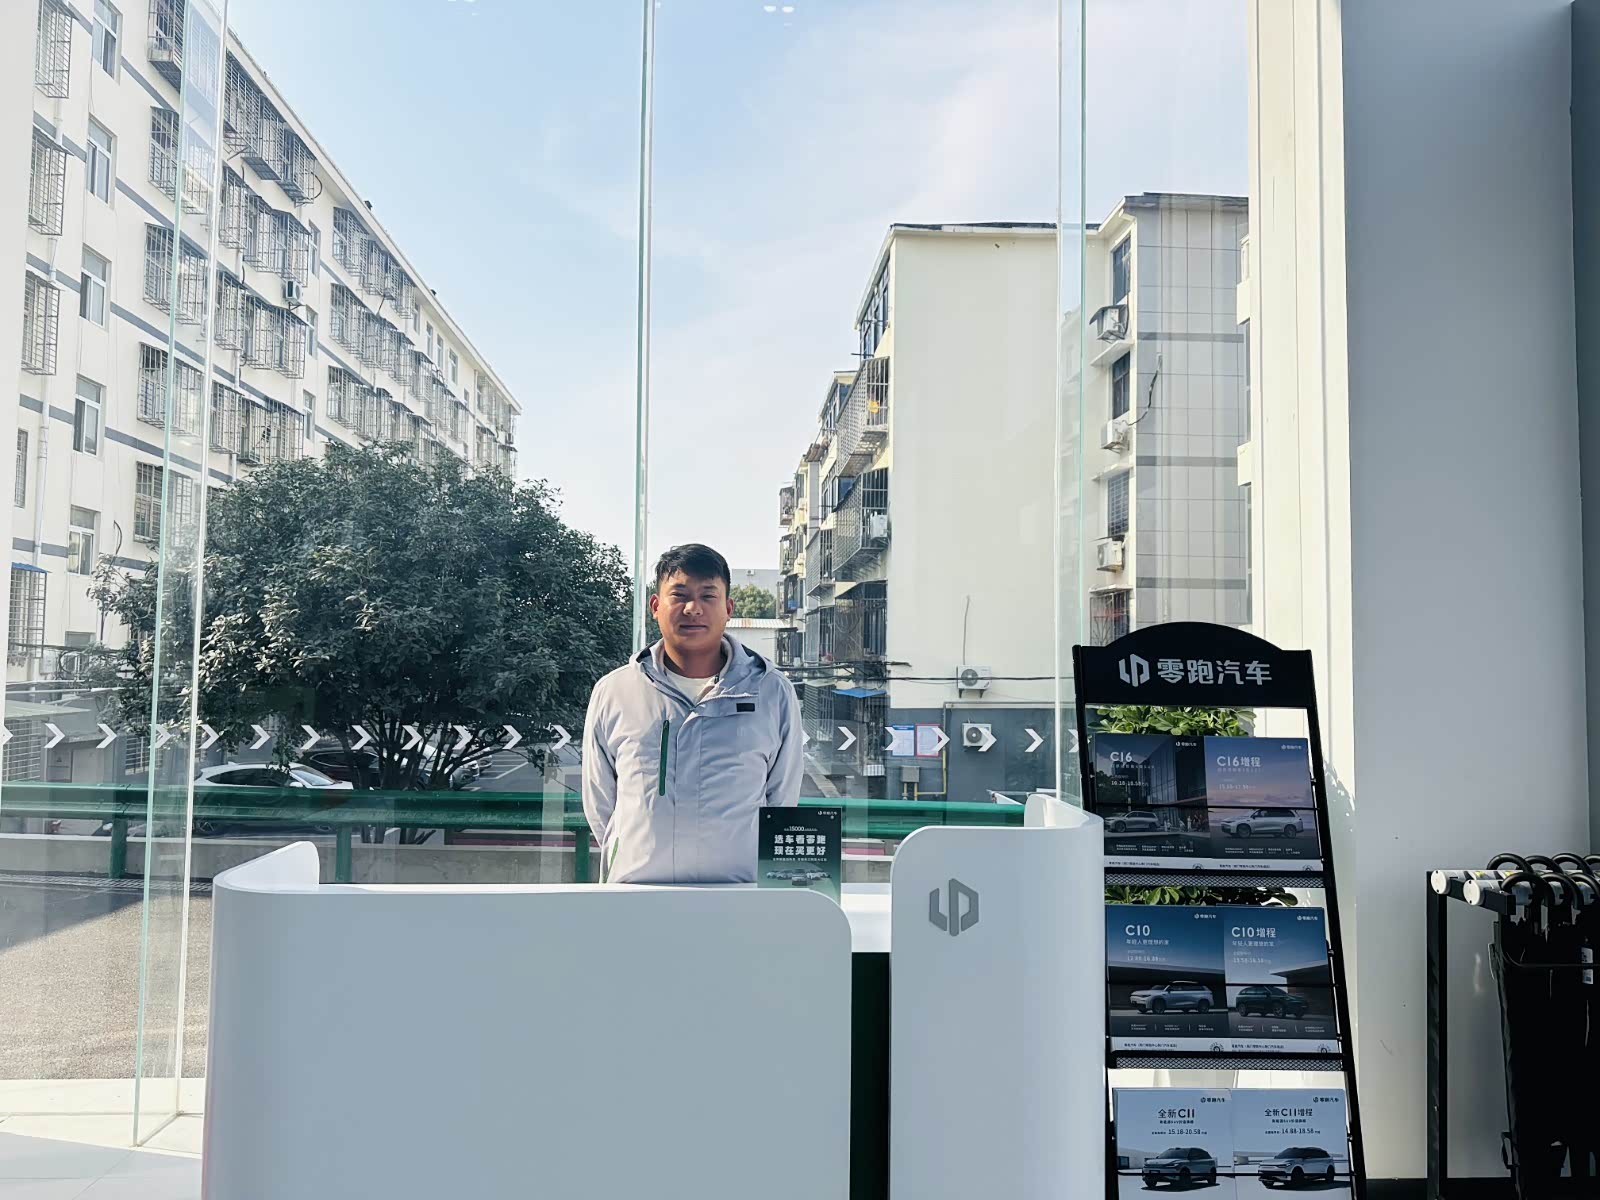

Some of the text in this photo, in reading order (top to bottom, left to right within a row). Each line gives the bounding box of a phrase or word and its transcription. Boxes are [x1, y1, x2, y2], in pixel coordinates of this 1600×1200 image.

[1157, 657, 1272, 686] 零跑汽车
[1110, 751, 1132, 762] C16
[1217, 755, 1261, 767] C16增程
[774, 835, 826, 844] 选车看零跑
[774, 846, 826, 855] 现在买更好
[1125, 924, 1151, 936] C10
[1231, 926, 1276, 938] C10增程
